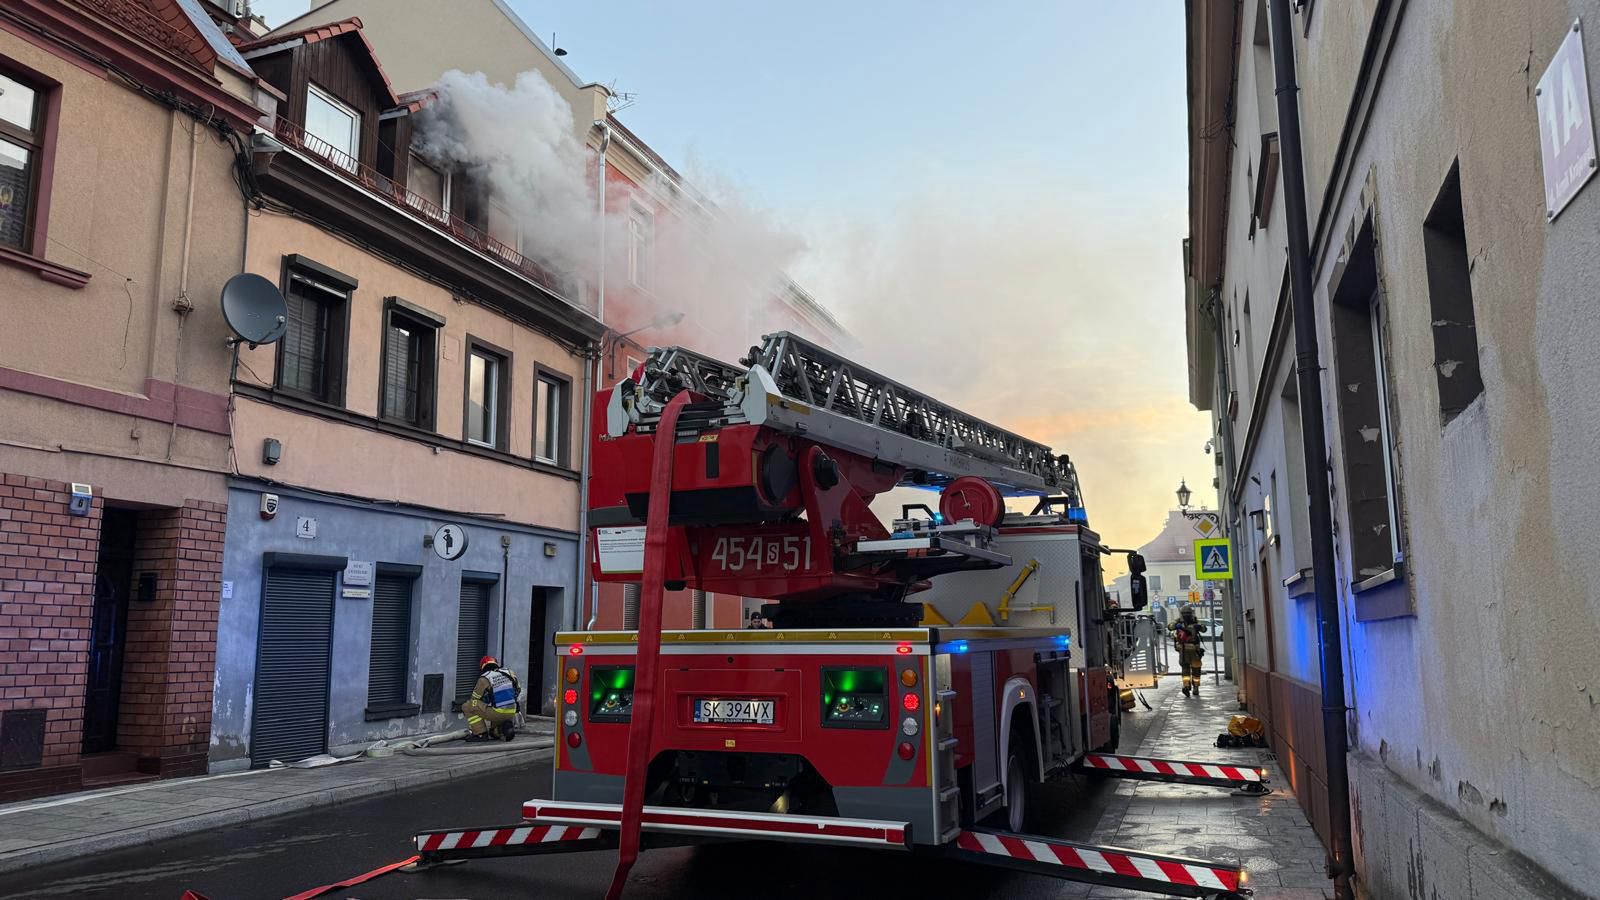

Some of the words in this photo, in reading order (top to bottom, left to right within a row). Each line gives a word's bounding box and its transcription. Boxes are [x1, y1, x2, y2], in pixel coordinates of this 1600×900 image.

[1545, 58, 1583, 160] 1A
[78, 499, 84, 508] 6
[302, 519, 310, 532] 4
[711, 537, 763, 571] 454
[768, 543, 778, 562] S
[783, 536, 811, 571] 51
[704, 702, 720, 718] SK
[726, 702, 770, 719] 394VX
